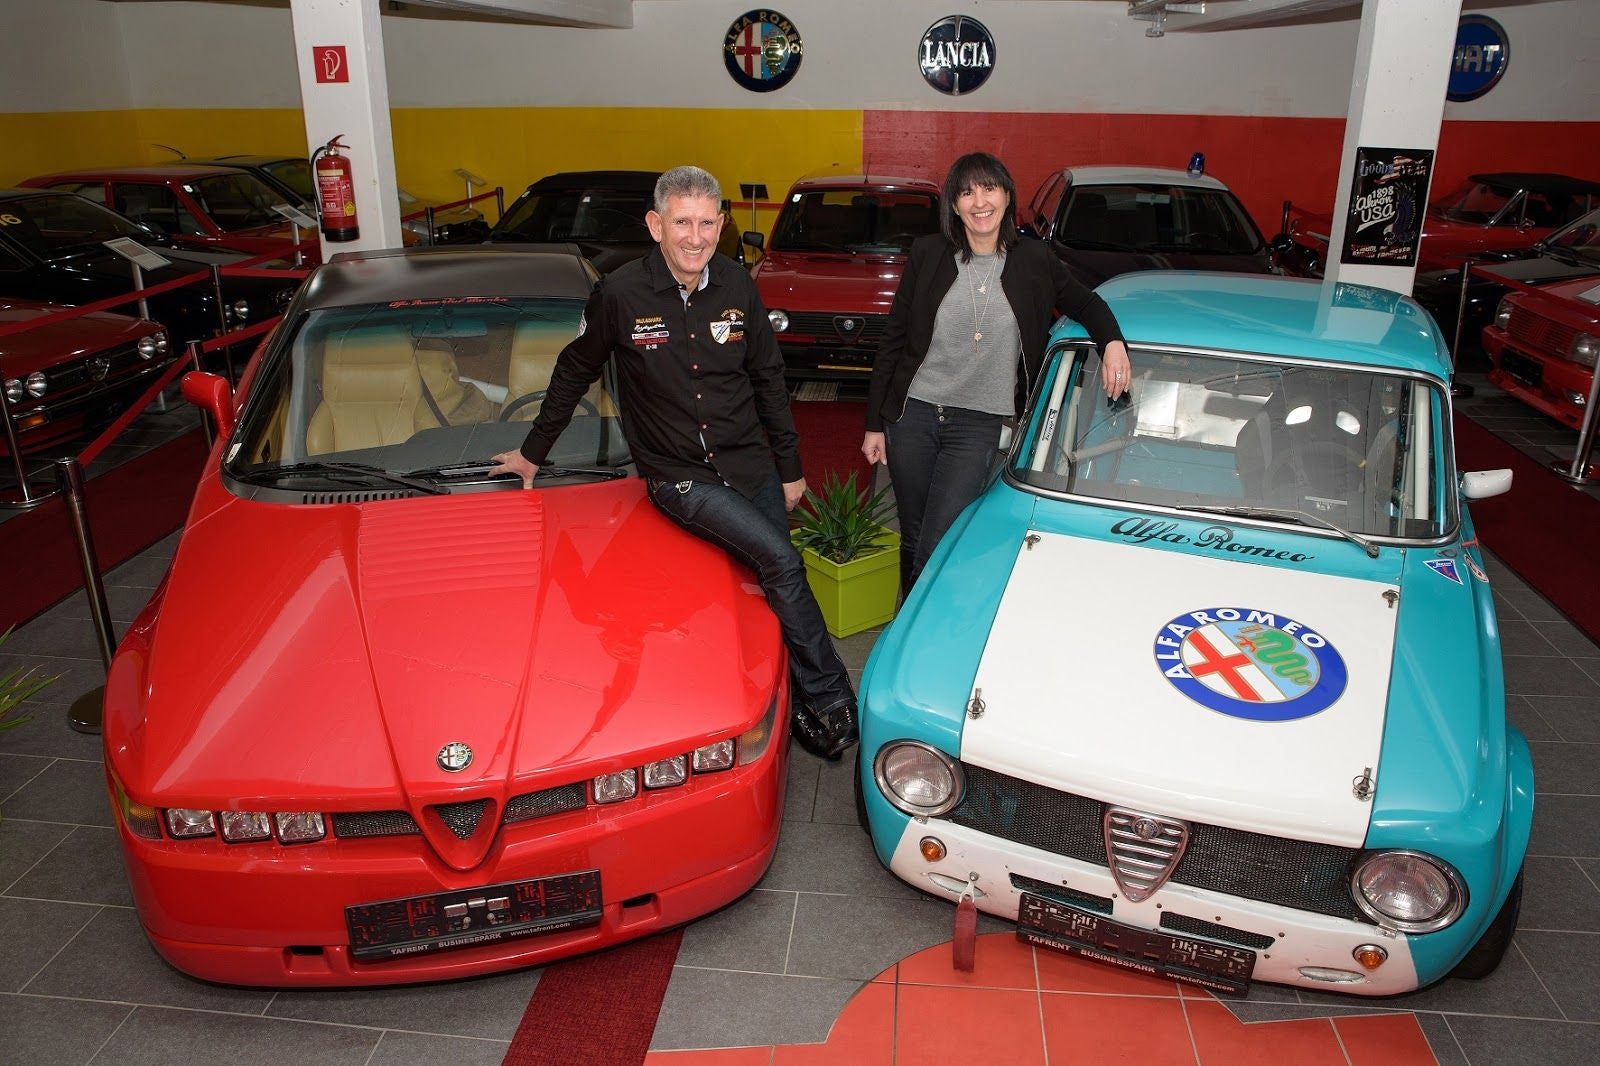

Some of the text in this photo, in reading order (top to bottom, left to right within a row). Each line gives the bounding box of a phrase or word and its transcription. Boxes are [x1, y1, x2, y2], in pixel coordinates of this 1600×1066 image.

[760, 11, 801, 54] ROMEO
[922, 40, 991, 68] LANCIA
[1455, 44, 1501, 73] IAT
[1371, 185, 1394, 199] 1898
[1361, 203, 1396, 223] USA
[1110, 517, 1315, 562] Alfa Romeo
[1157, 608, 1326, 679] ALFA ROMEO
[391, 921, 571, 955] TAFRENT BUSINESSPARK www.tafrent.com
[1027, 934, 1235, 992] TAFRENT BUSINESSPARK www.tafrent.com
